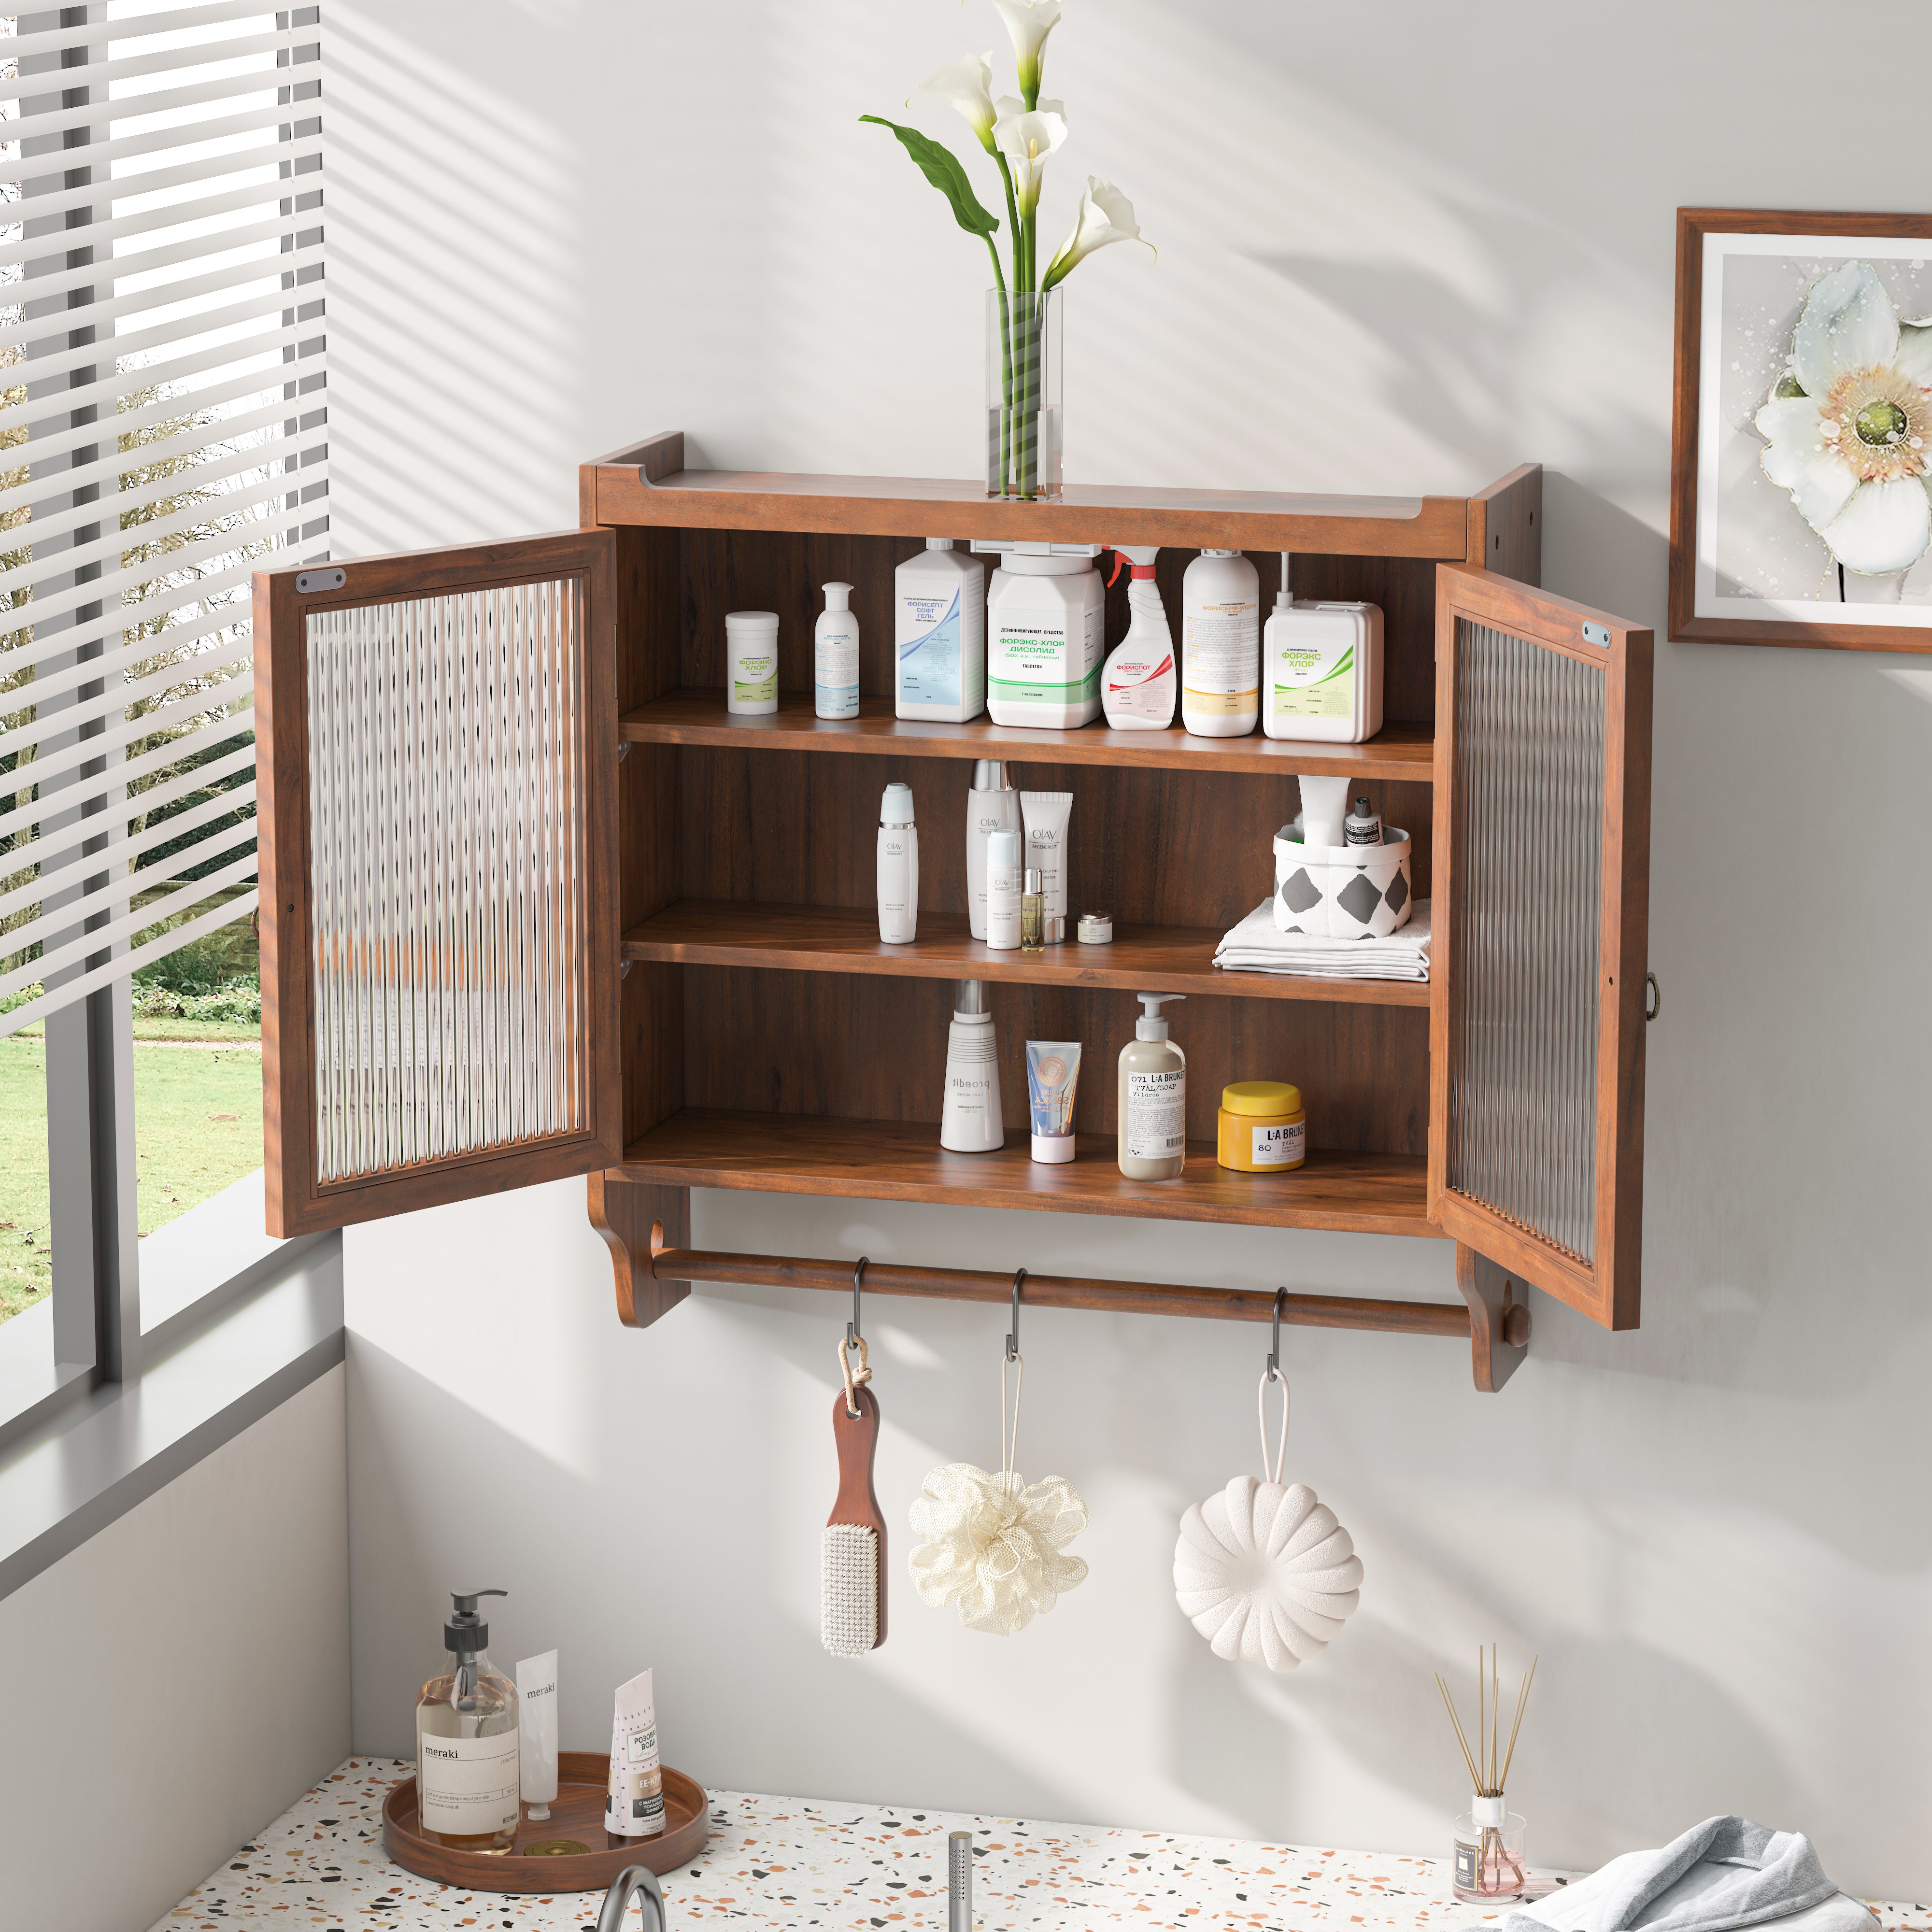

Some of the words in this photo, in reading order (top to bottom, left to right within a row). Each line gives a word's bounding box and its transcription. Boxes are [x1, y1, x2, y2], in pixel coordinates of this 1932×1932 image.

[1000, 638, 1065, 646] ФОРЭКС-ХЛОР
[1165, 1070, 1185, 1081] BRUKET
[1268, 1130, 1280, 1140] L:A
[527, 1682, 554, 1699] meraki
[641, 1739, 655, 1750] ВОДА
[426, 1747, 458, 1758] meraki
[503, 1813, 517, 1824] BODYWASH
